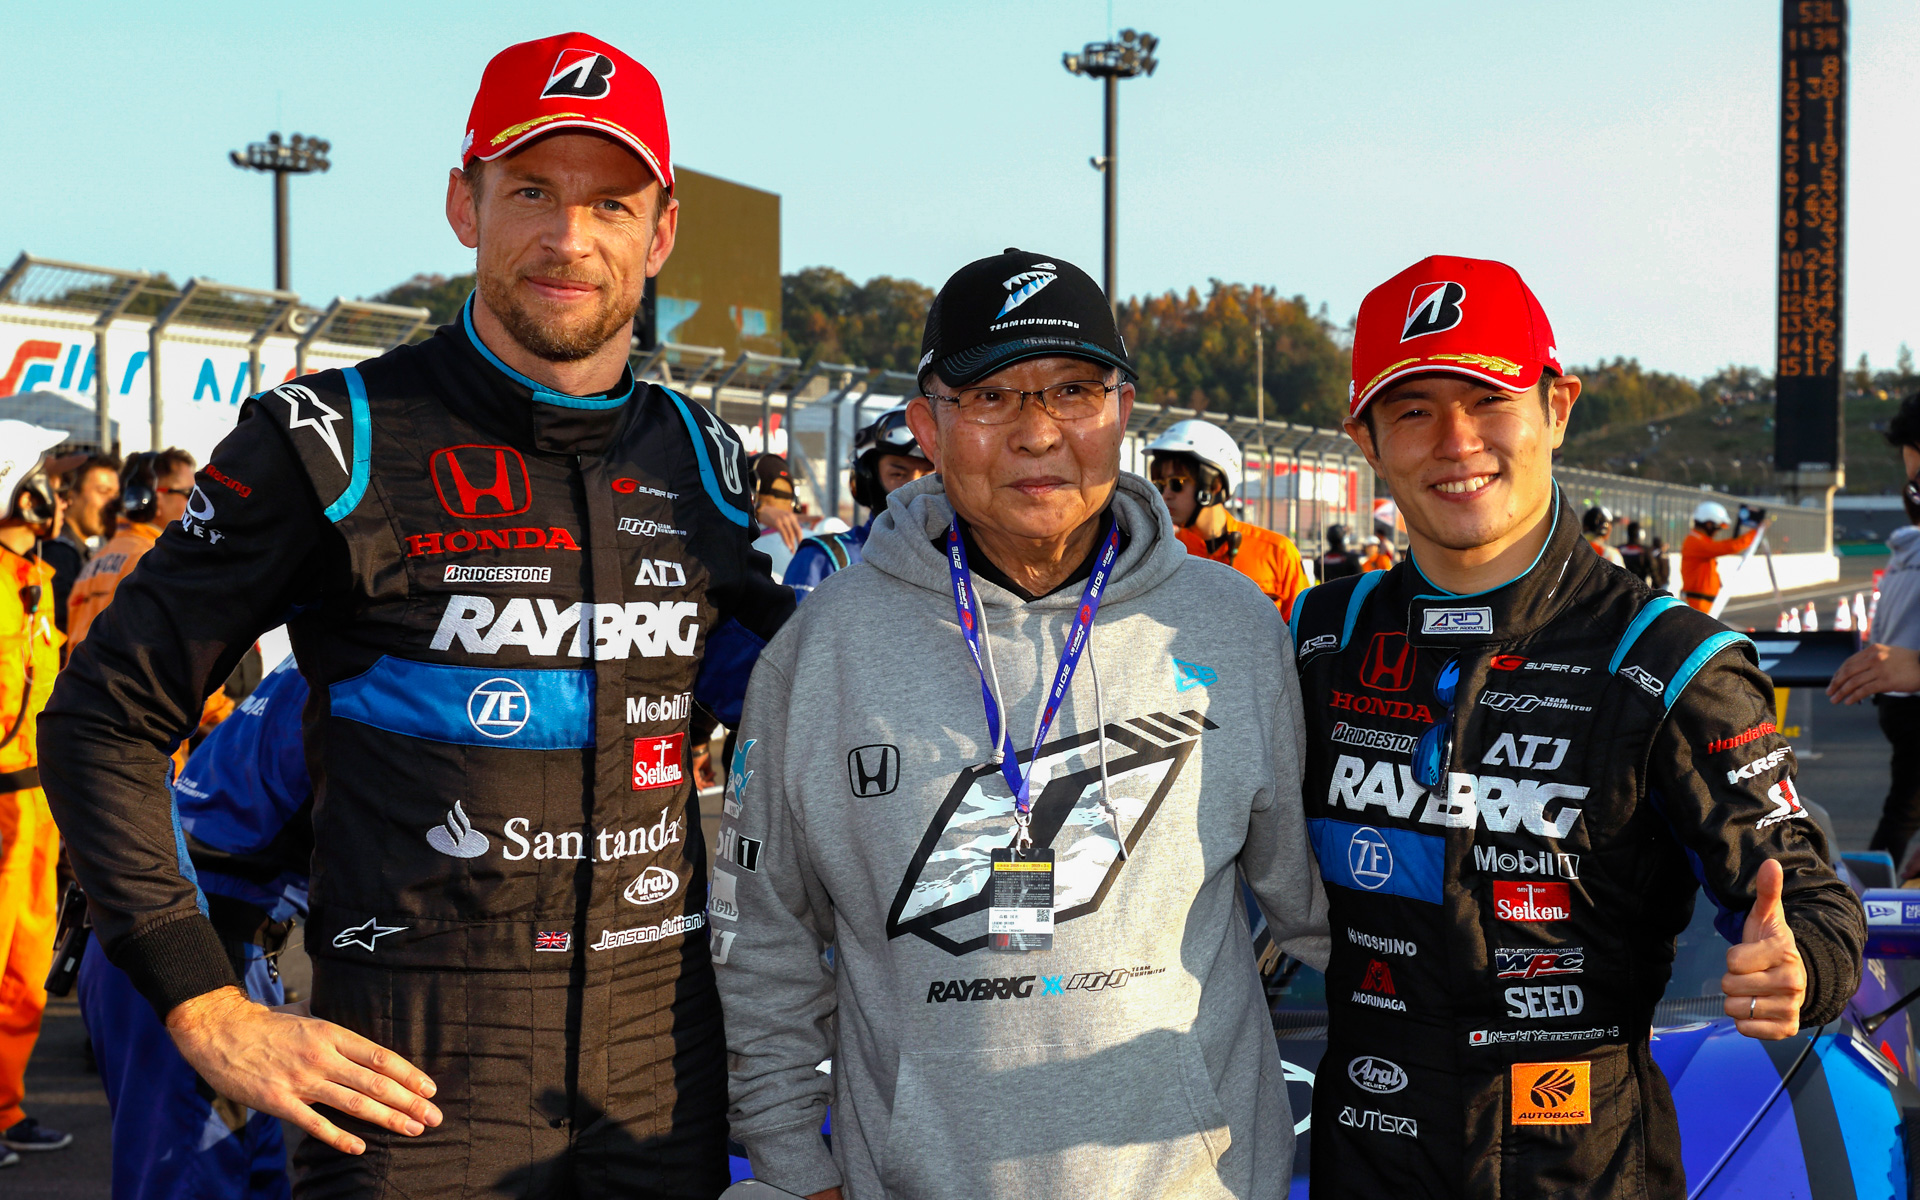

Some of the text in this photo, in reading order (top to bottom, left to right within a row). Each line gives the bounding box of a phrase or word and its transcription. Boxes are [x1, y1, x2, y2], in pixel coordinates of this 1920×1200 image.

[1788, 59, 1797, 79] 1
[1786, 80, 1800, 99] 2
[1786, 101, 1800, 121] 3
[1786, 124, 1799, 142] 4
[1785, 144, 1799, 164] 5
[1785, 166, 1799, 185] 6
[1785, 186, 1798, 206] 7
[1784, 208, 1799, 228] 8
[1784, 229, 1798, 249] 9
[1781, 251, 1803, 270] 10
[1781, 273, 1800, 292] 11
[1781, 294, 1802, 313] 12
[1780, 314, 1802, 334] 13
[1780, 336, 1801, 355] 14
[1780, 357, 1801, 376] 15
[405, 527, 581, 558] HONDA
[444, 565, 551, 583] BRIDGESTONE
[1090, 571, 1105, 598] 2018
[429, 595, 700, 661] RAYBRIG
[1524, 662, 1591, 675] SUPER GT
[1055, 664, 1071, 699] 2018
[474, 690, 523, 727] ZF
[626, 694, 681, 724] Mobil
[1330, 689, 1434, 723] HONDA
[1544, 696, 1568, 704] TEAM
[1331, 722, 1417, 753] BRIDGESTO
[1708, 727, 1761, 755] Honda
[634, 740, 682, 786] Seiken
[1328, 754, 1591, 839] RAYBRIG
[1352, 838, 1389, 879] ZF
[1474, 845, 1554, 876] Mobil
[1497, 884, 1569, 919] Seiken
[591, 925, 661, 951] Jenson
[1357, 931, 1417, 957] HOSHINO
[927, 976, 1037, 1003] RAYBRIG
[1351, 991, 1407, 1012] MORINAGA
[1504, 985, 1584, 1018] SEED
[1490, 1030, 1531, 1043] Naoki
[1532, 1028, 1605, 1042] Yamamoto
[1352, 1060, 1401, 1086] Arai
[1518, 1110, 1585, 1119] AUTOBACS
